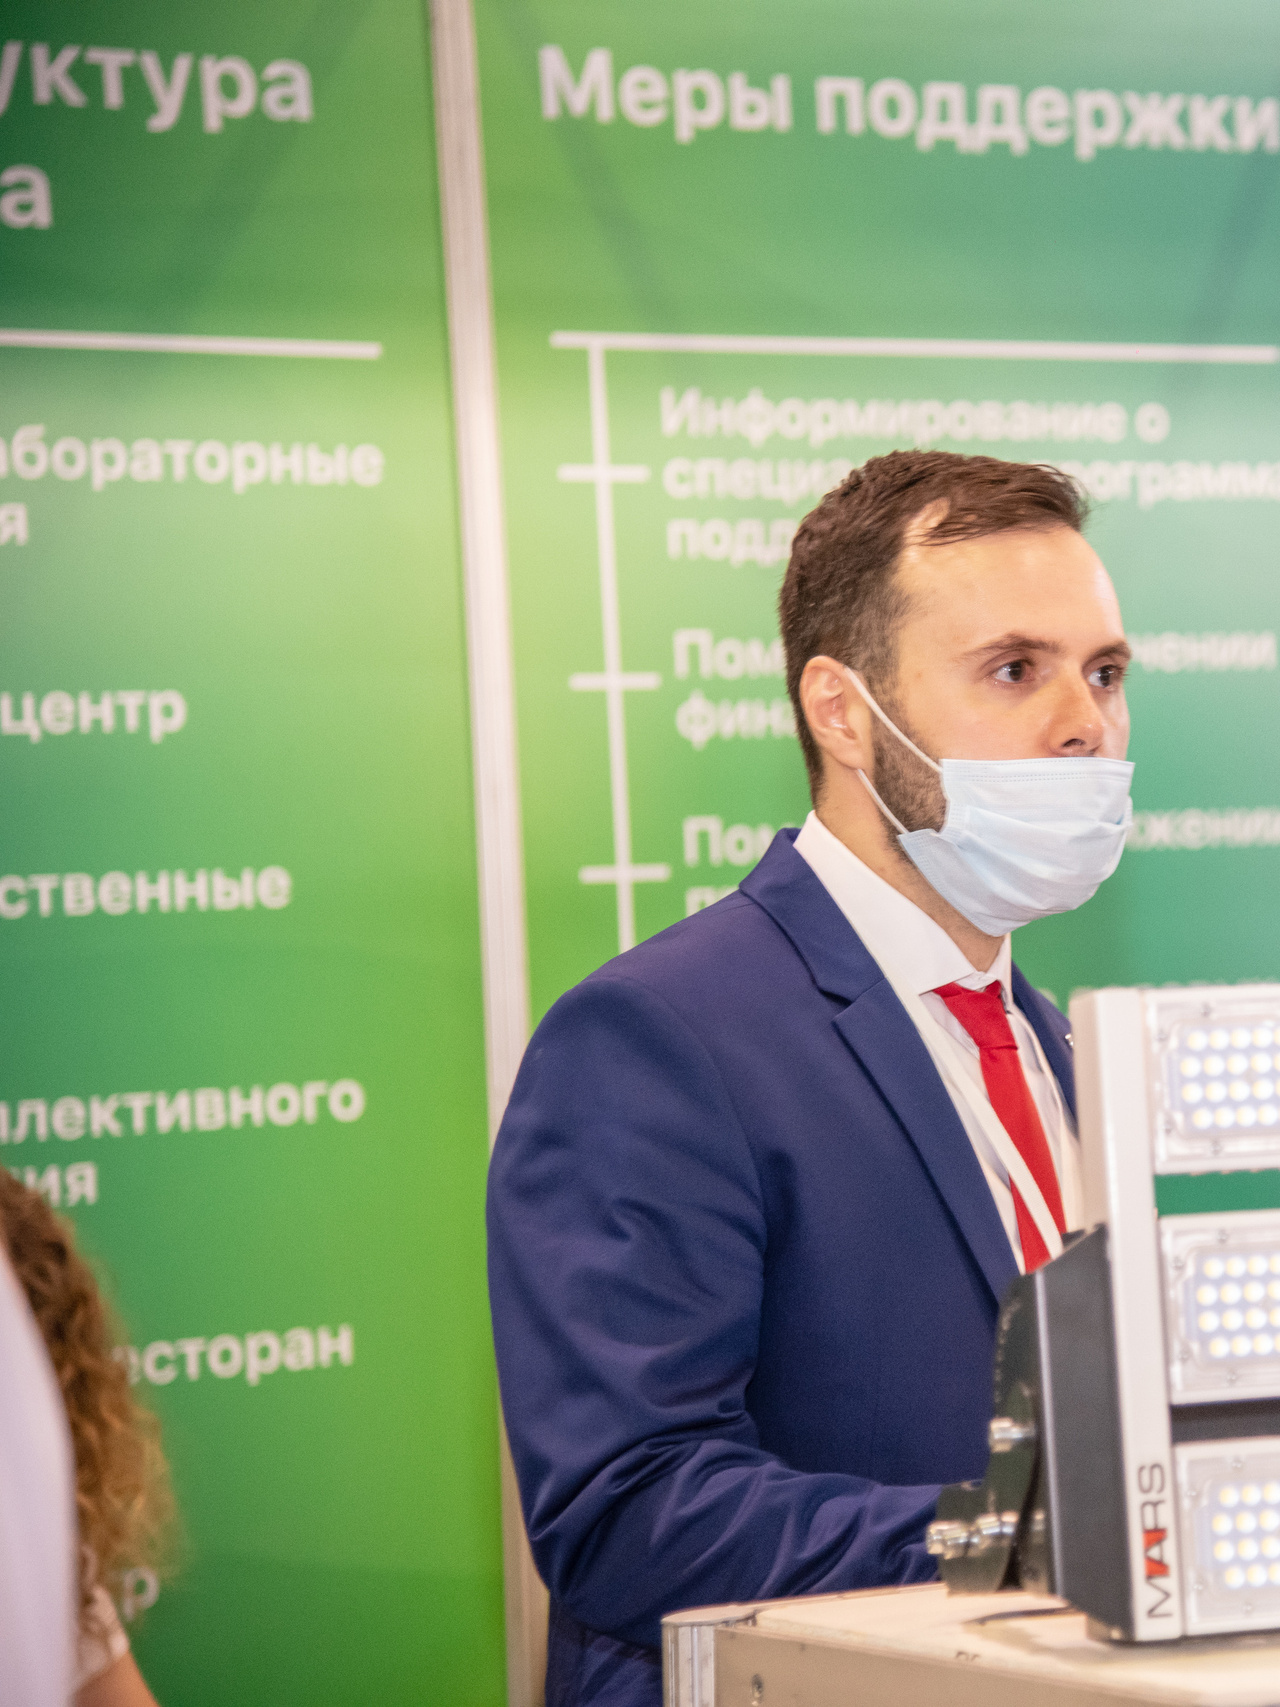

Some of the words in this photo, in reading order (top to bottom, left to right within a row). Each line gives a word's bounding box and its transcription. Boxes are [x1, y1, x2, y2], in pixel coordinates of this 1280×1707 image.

[538, 45, 791, 144] Меры
[660, 386, 1127, 449] Информирование
[1134, 401, 1170, 444] о
[0, 423, 385, 493] бораторные
[0, 689, 188, 743] центр
[0, 1078, 365, 1144] лективного
[1137, 1462, 1173, 1620] MARS
